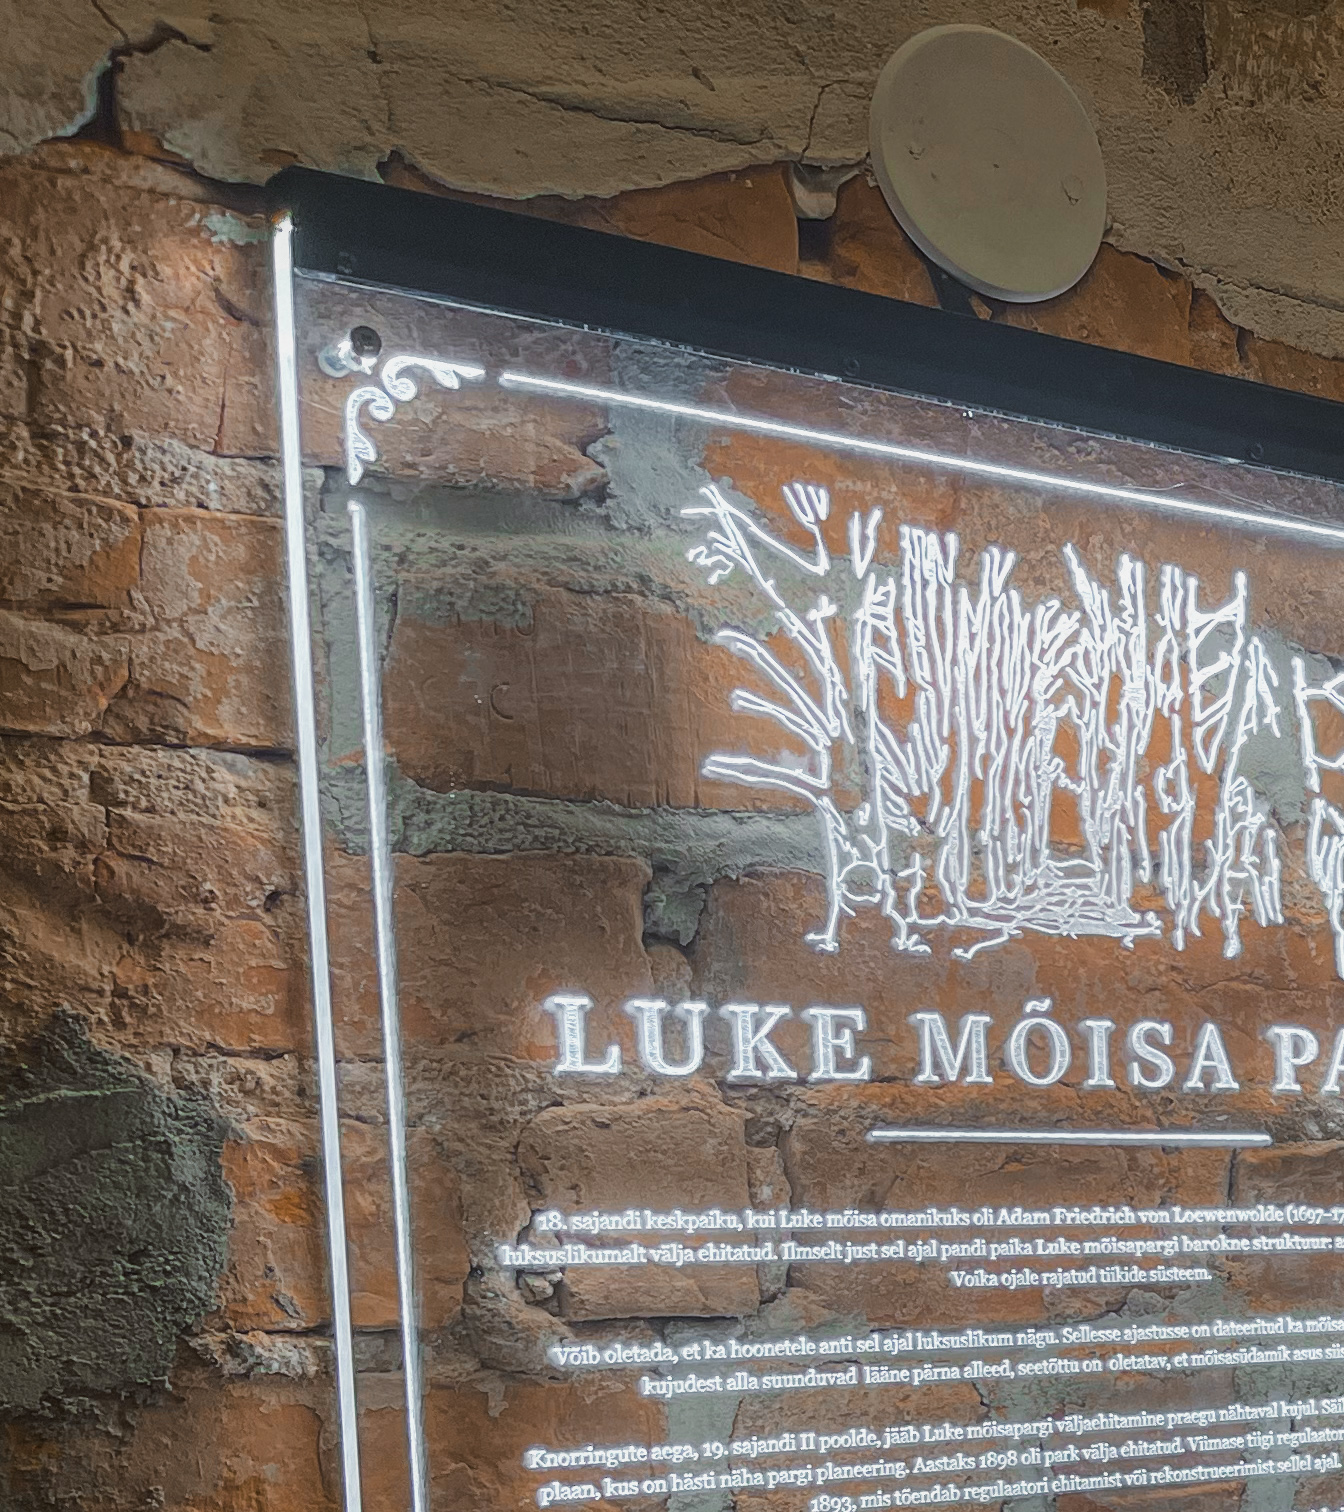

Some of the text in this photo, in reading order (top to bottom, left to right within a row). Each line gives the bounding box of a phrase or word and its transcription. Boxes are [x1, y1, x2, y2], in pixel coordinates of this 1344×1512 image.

[551, 996, 869, 1080] LUKE
[916, 999, 1239, 1089] MÕISA
[537, 1211, 567, 1230] 18.
[570, 1210, 642, 1233] sajandi
[643, 1210, 743, 1233] keskpaiku,
[745, 1210, 776, 1228] kui
[778, 1209, 823, 1227] Luke
[825, 1210, 878, 1226] mõisa
[880, 1208, 970, 1226] omanikuks
[972, 1208, 994, 1225] oli
[996, 1208, 1050, 1224] Adam
[1052, 1206, 1136, 1224] Friedrich
[1137, 1210, 1170, 1223] von
[1172, 1205, 1284, 1222] Loewenwolde
[501, 1244, 647, 1265] luksuslikumalt
[648, 1243, 695, 1265] välja
[696, 1242, 778, 1261] ehitatud.
[780, 1241, 843, 1259] Ilmselt
[844, 1242, 878, 1262] just
[880, 1240, 904, 1257] sel
[907, 1240, 937, 1261] ajal
[940, 1239, 987, 1260] pandi
[989, 1238, 1033, 1259] paika
[1034, 1237, 1081, 1254] Luke
[1082, 1236, 1179, 1256] mõisapargi
[1180, 1234, 1250, 1251] barokne
[950, 1265, 1210, 1289] Voika ojale rajatud tiikide süsteem.
[642, 1374, 723, 1397] kujudest
[726, 1372, 759, 1390] alla
[762, 1366, 858, 1388] suunduvad
[863, 1366, 910, 1383] lääne
[912, 1364, 961, 1385] pärna
[963, 1359, 1015, 1378] alleed,
[1017, 1358, 1080, 1375] seetõttu
[1082, 1360, 1103, 1371] on
[1108, 1353, 1171, 1370] oletatav,
[1173, 1353, 1189, 1367] et
[1190, 1345, 1291, 1366] mõisasüdamik
[1293, 1348, 1323, 1360] asus
[855, 1490, 891, 1509] mis
[893, 1484, 960, 1505] tõendab
[963, 1477, 1049, 1501] regulaatori
[1051, 1472, 1122, 1491] ehitamist
[1123, 1469, 1147, 1485] või
[1150, 1459, 1275, 1483] rekonstrueerimist
[1276, 1455, 1311, 1472] sellel
[1314, 1452, 1340, 1472] ajal.
